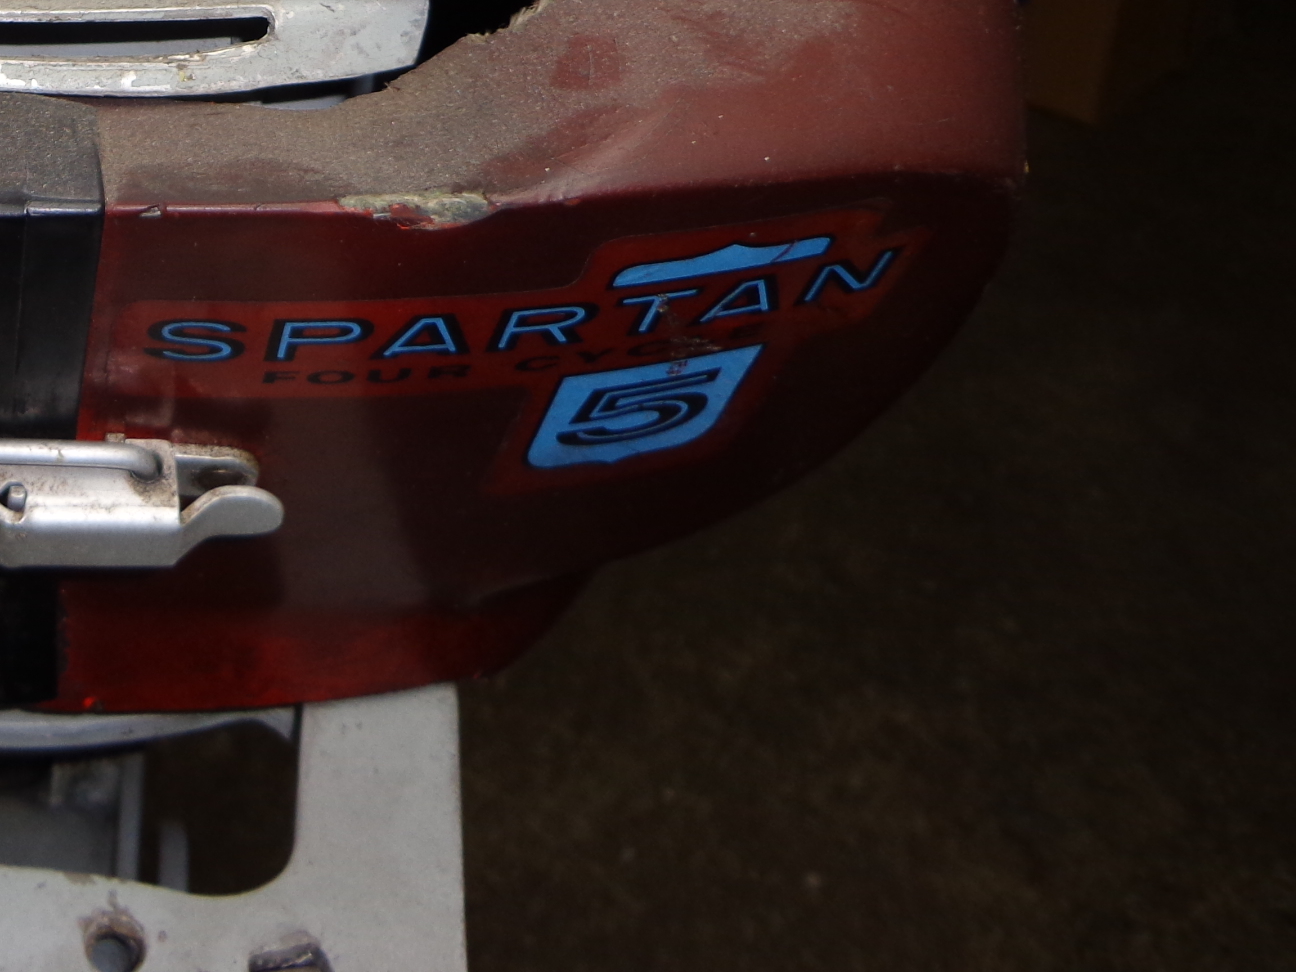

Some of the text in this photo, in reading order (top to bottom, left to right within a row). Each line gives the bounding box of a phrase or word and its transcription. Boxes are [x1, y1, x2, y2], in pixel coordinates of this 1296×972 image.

[145, 248, 903, 364] SPARTAN
[262, 363, 472, 386] FOUR
[555, 367, 722, 446] 5
